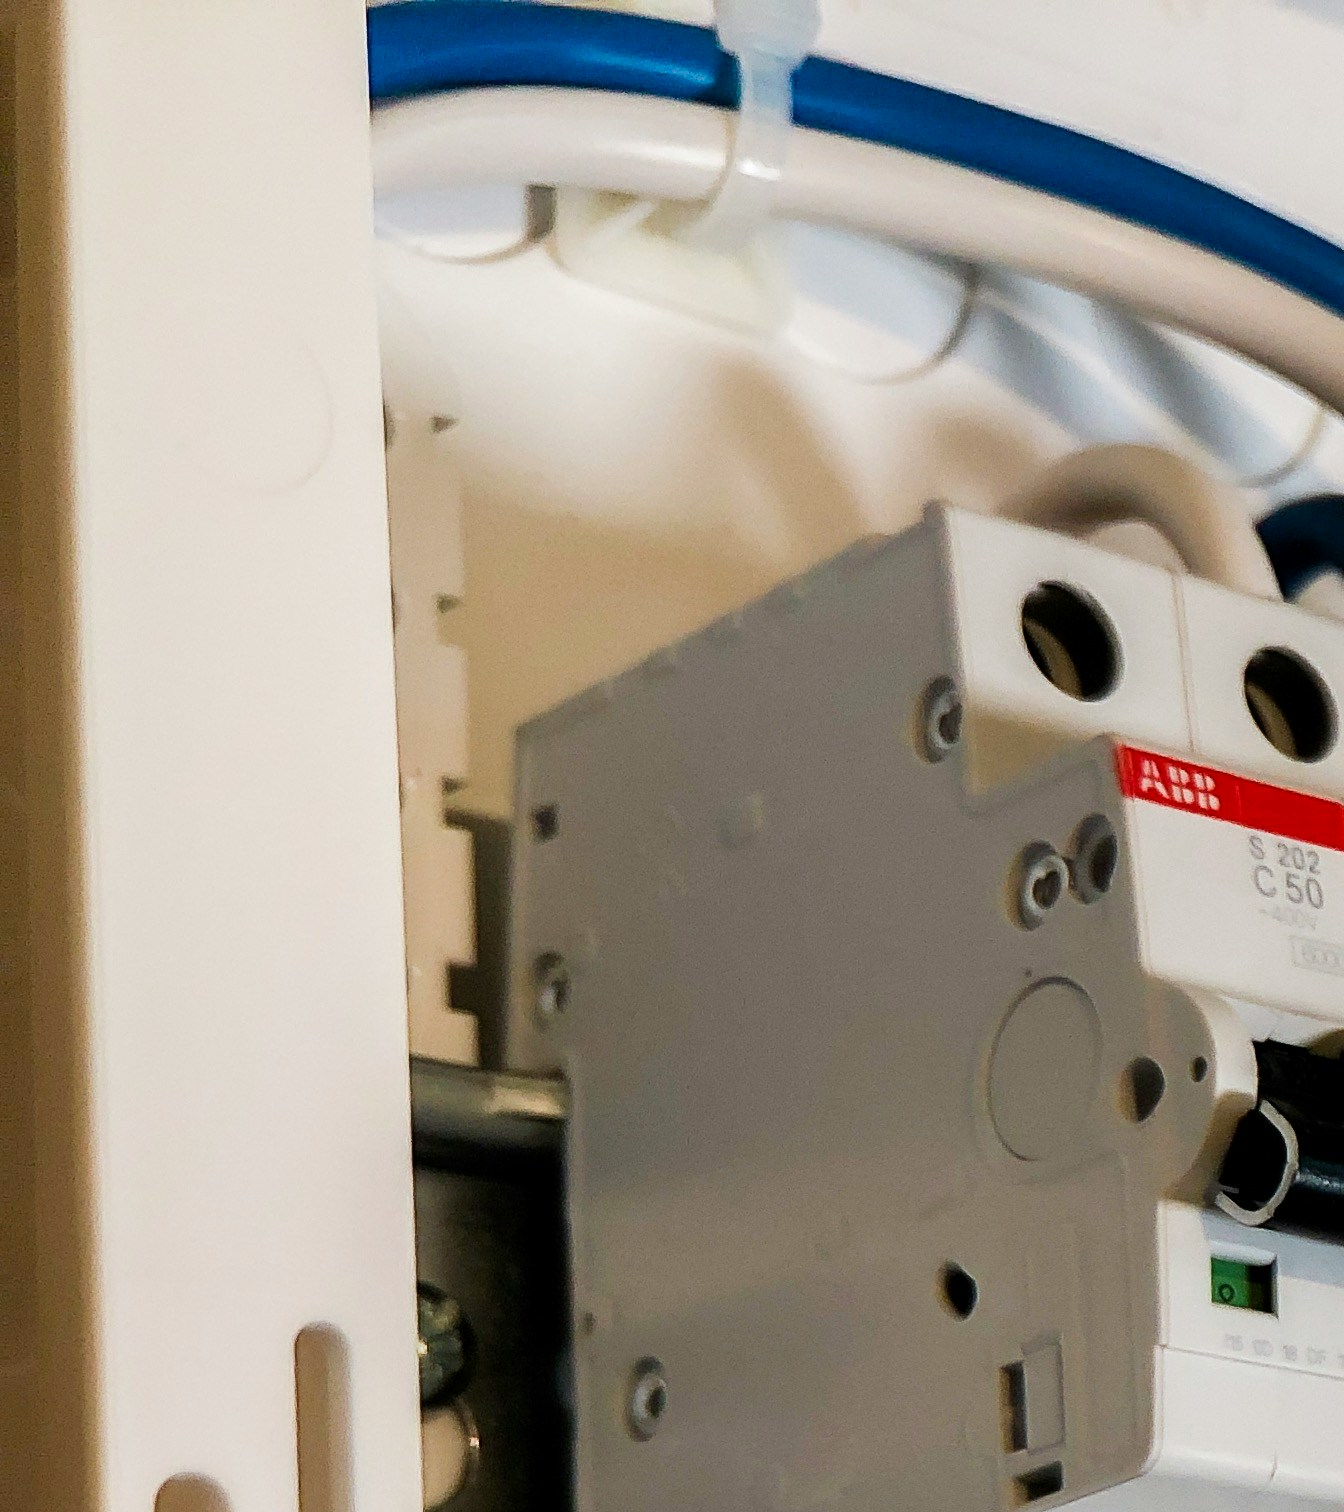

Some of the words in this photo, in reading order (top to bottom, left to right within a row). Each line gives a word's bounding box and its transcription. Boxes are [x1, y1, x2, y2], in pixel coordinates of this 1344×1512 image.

[1141, 759, 1221, 811] ABB
[1248, 835, 1265, 860] S
[1277, 843, 1321, 875] 202
[1253, 865, 1277, 898] C
[1285, 872, 1324, 909] 50
